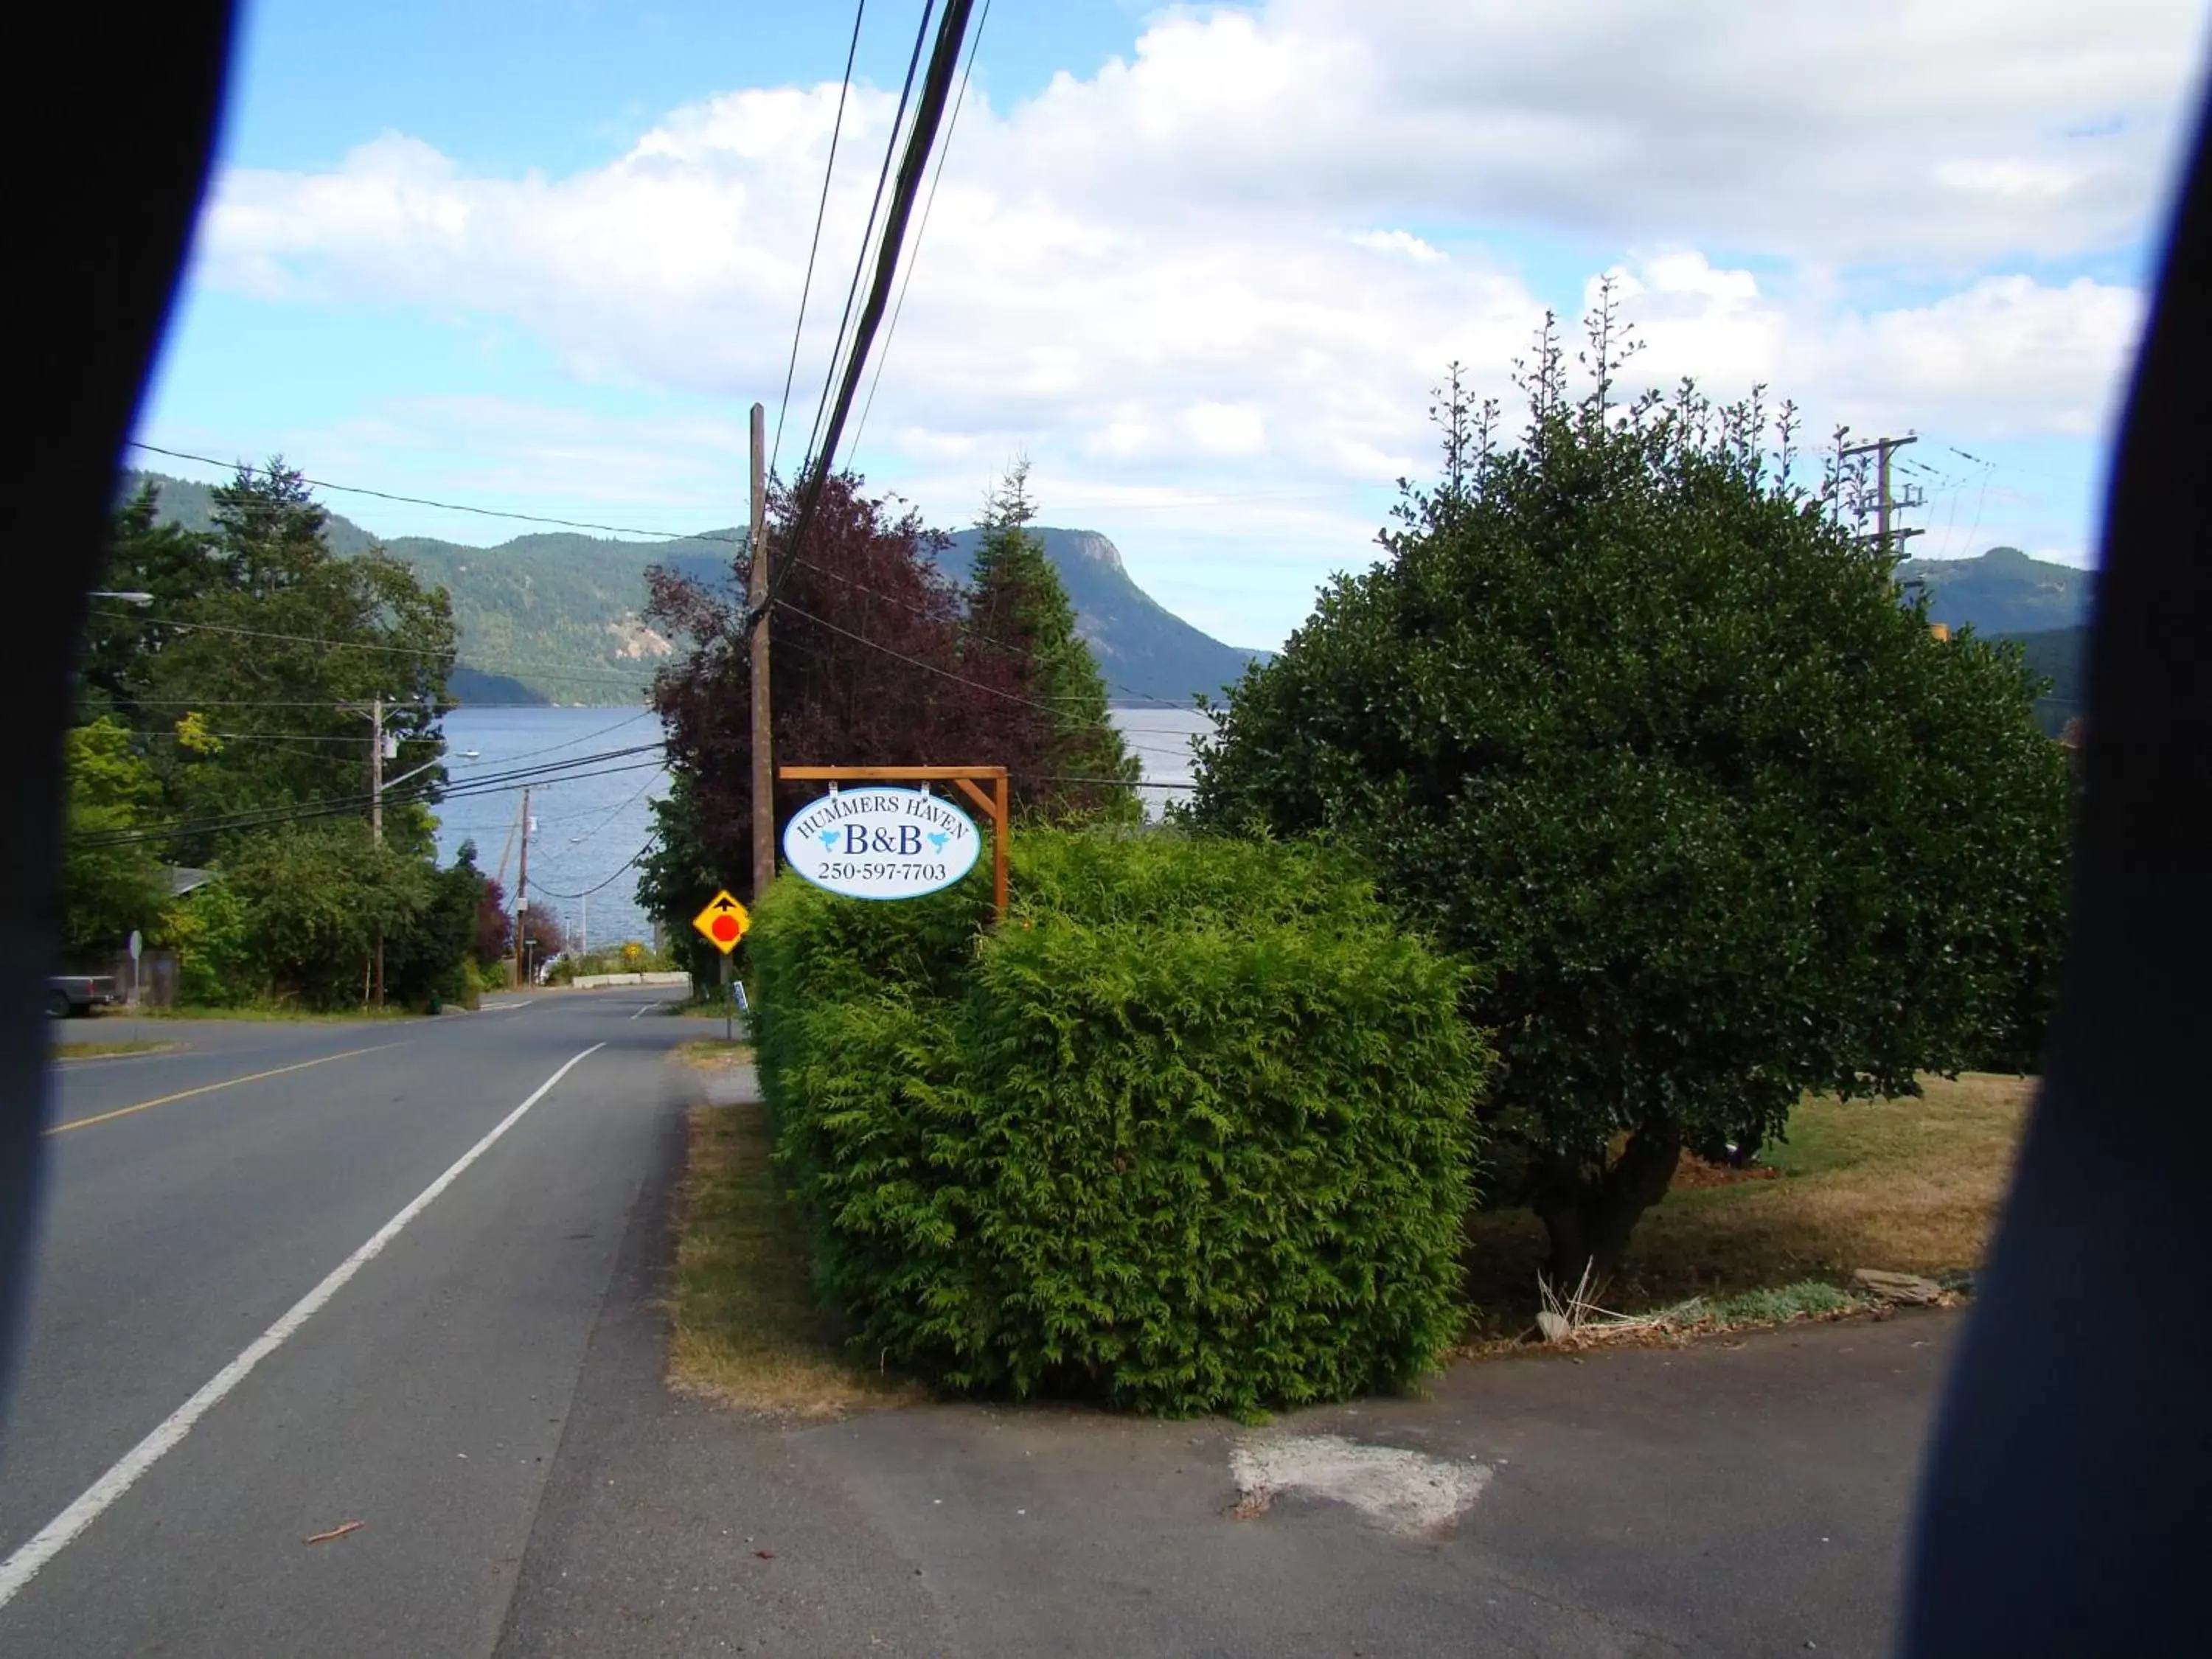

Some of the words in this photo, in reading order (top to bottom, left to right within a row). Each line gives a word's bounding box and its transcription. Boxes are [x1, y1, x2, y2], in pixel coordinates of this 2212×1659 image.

[797, 796, 899, 839] HUMMERS
[905, 799, 969, 840] HAVEN
[844, 824, 922, 855] B&B
[818, 863, 947, 880] 250-597-7703
